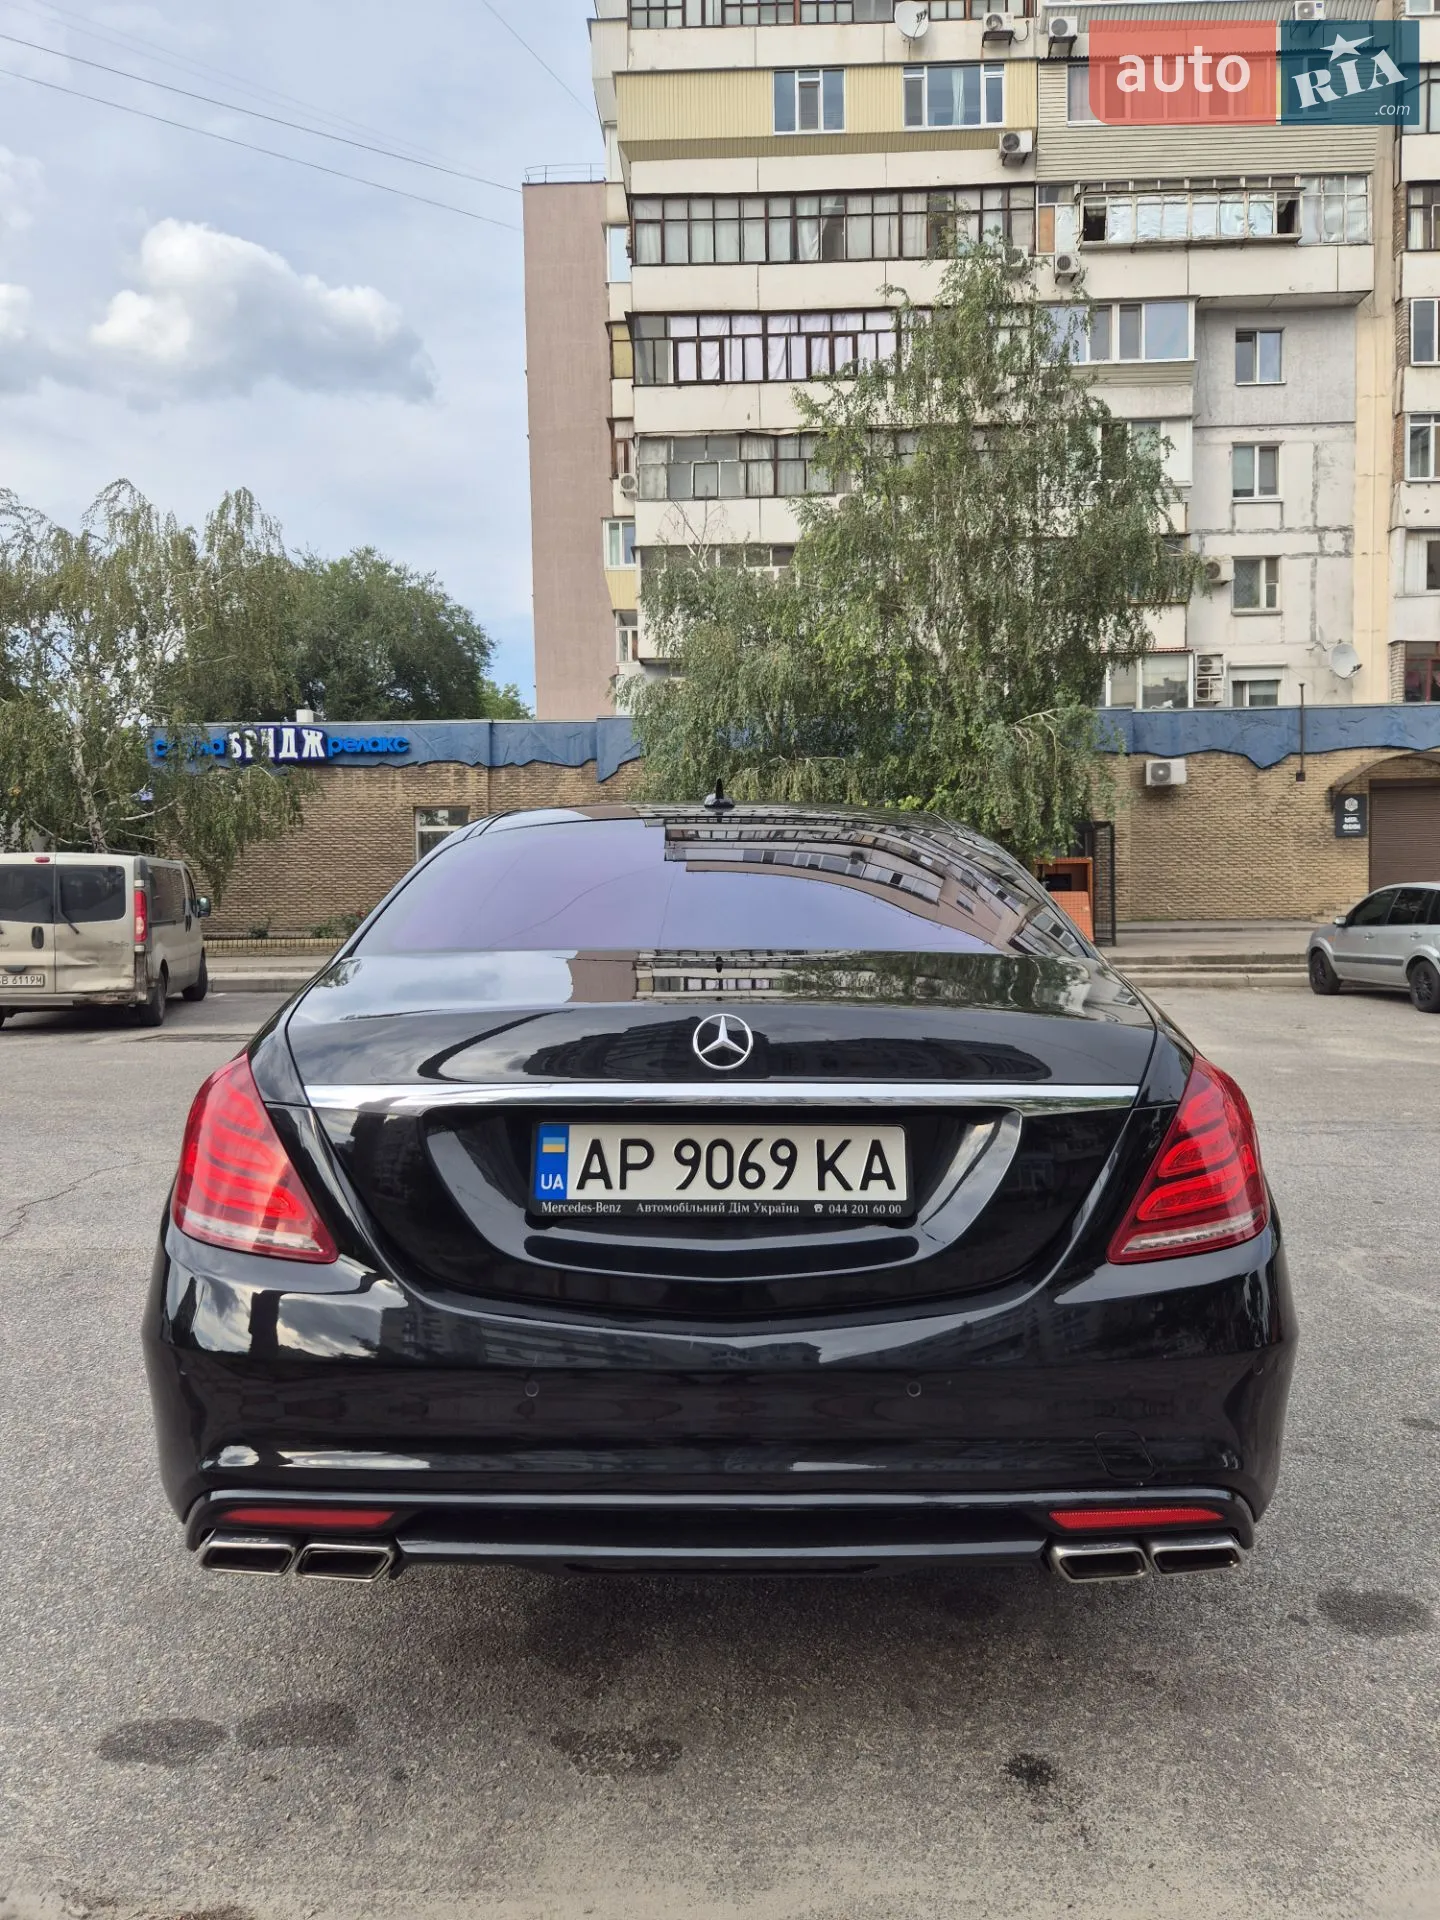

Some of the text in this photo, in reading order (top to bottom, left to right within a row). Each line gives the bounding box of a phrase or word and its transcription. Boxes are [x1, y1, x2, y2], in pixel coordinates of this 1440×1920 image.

[328, 736, 410, 755] релакс
[576, 1138, 896, 1191] AP 9069 KA
[540, 1174, 564, 1190] UA
[541, 1201, 622, 1214] Mercedes-Benz
[636, 1202, 800, 1216] Автомобільний Дім Україна
[828, 1203, 902, 1214] 044 201 60 00
